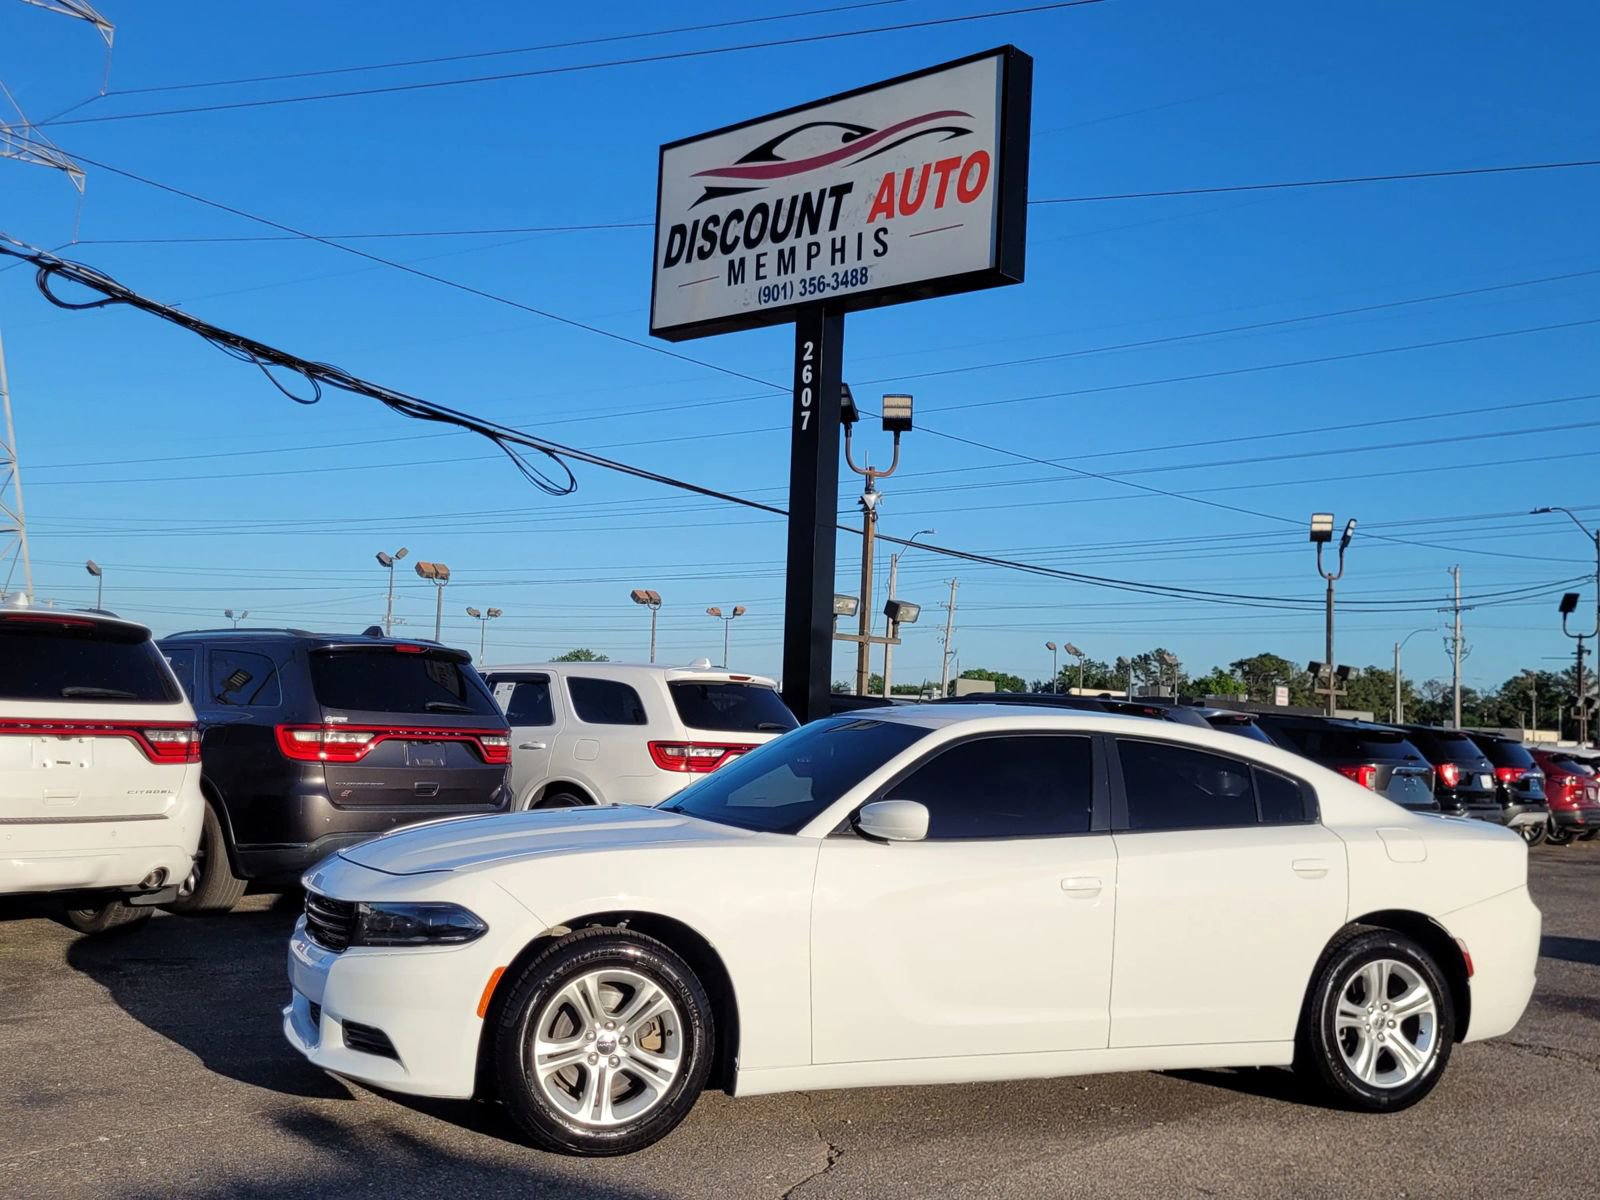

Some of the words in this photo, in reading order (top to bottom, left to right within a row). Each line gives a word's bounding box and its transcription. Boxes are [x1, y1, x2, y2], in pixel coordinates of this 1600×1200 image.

[663, 181, 854, 269] DISCOUNT
[866, 150, 990, 223] AUTO
[727, 227, 889, 286] MEMPHIS
[758, 282, 794, 305] (901)
[798, 267, 869, 297] 356-3488
[801, 341, 814, 431] 2607
